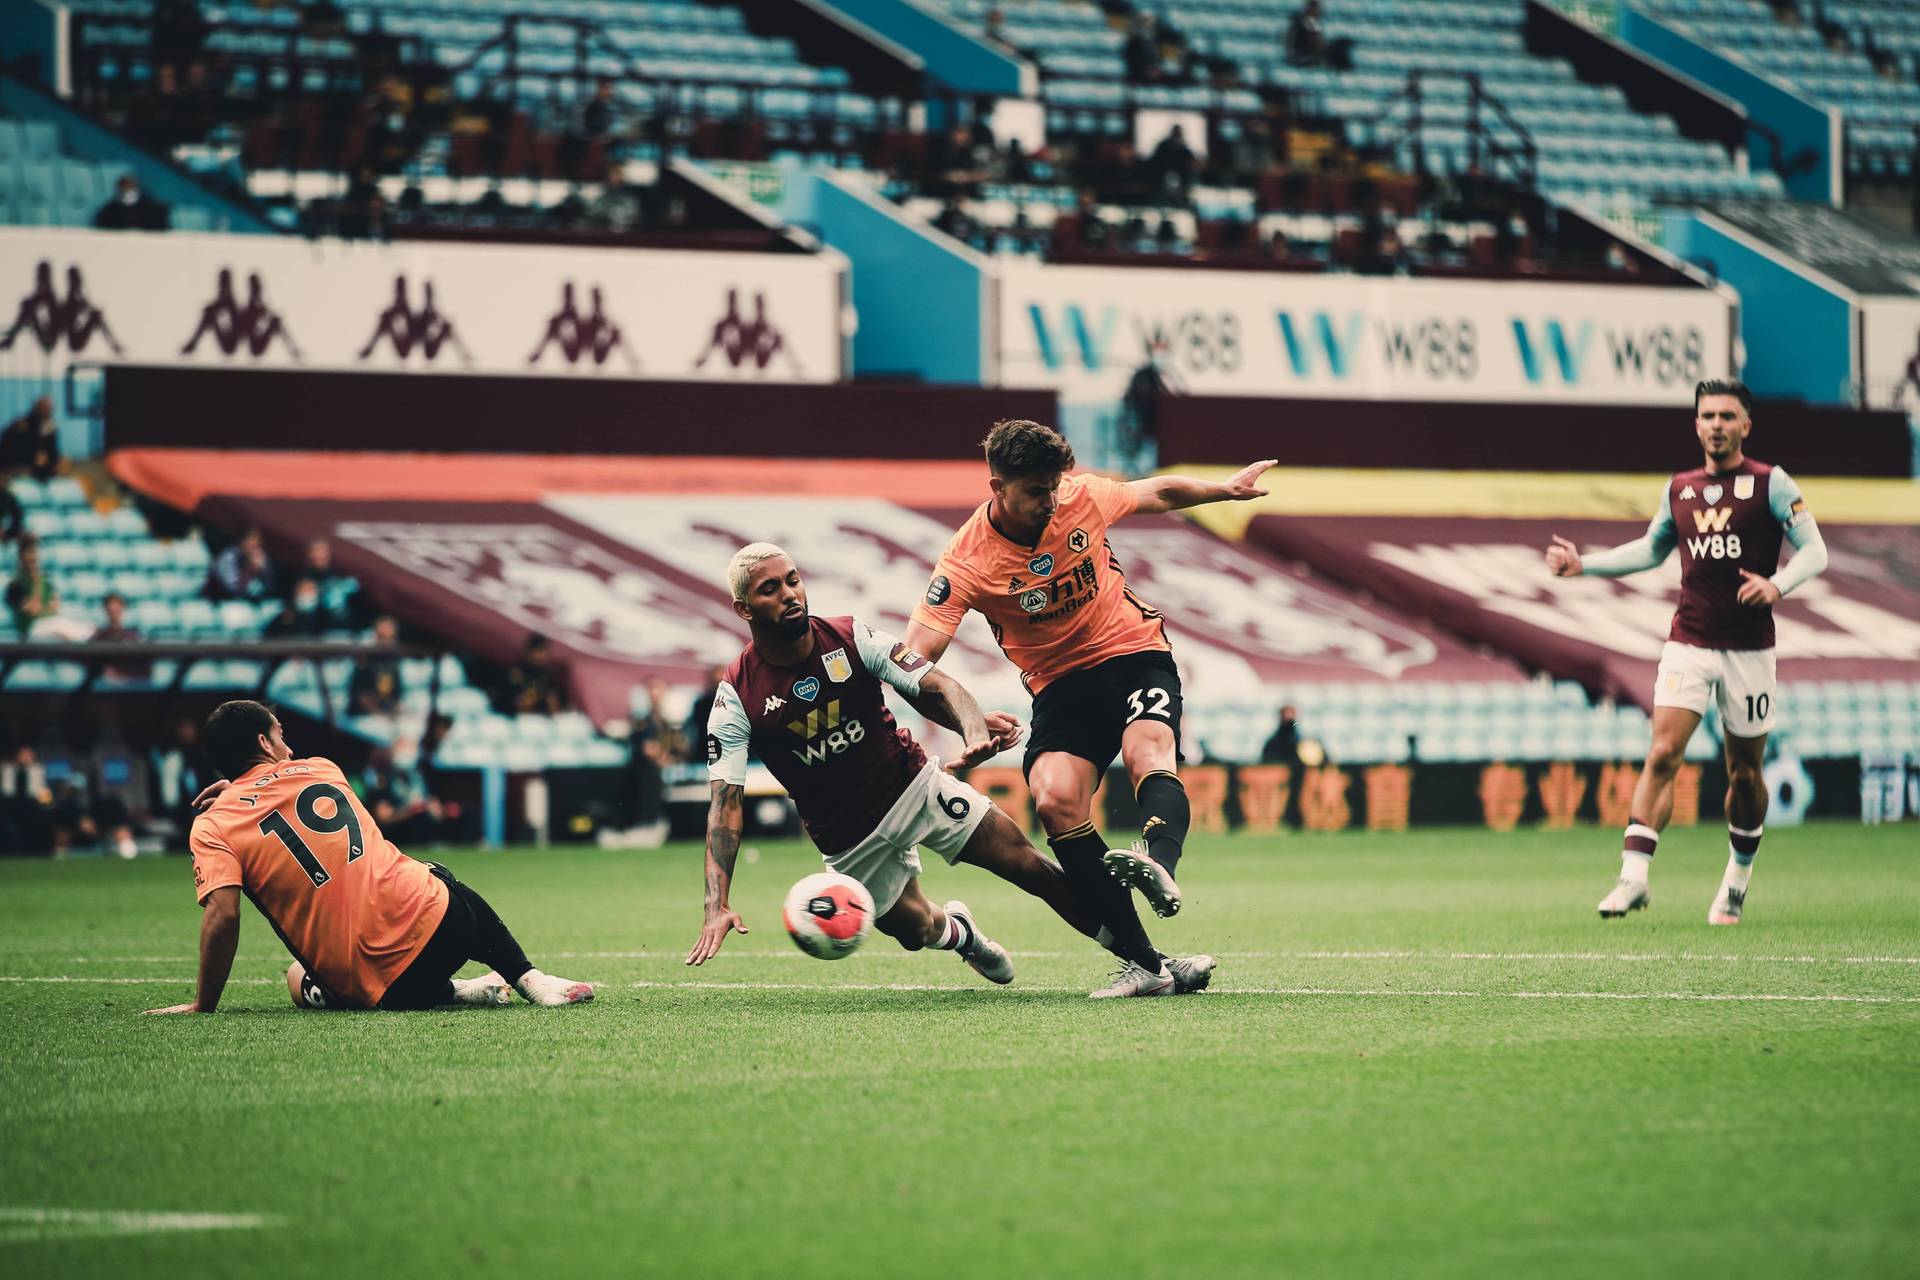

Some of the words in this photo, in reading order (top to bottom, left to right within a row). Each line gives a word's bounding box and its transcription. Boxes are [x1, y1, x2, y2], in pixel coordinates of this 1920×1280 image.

[1130, 311, 1241, 373] W88
[1373, 318, 1478, 378] W88
[1604, 326, 1706, 385] W88
[1687, 534, 1742, 560] W88
[1034, 559, 1051, 572] NHS
[825, 650, 845, 662] AVFC
[799, 682, 816, 695] NHS
[1126, 687, 1171, 724] 32
[1746, 693, 1770, 722] 10
[791, 720, 865, 766] W88
[936, 791, 971, 821] 6
[257, 783, 365, 889] 19
